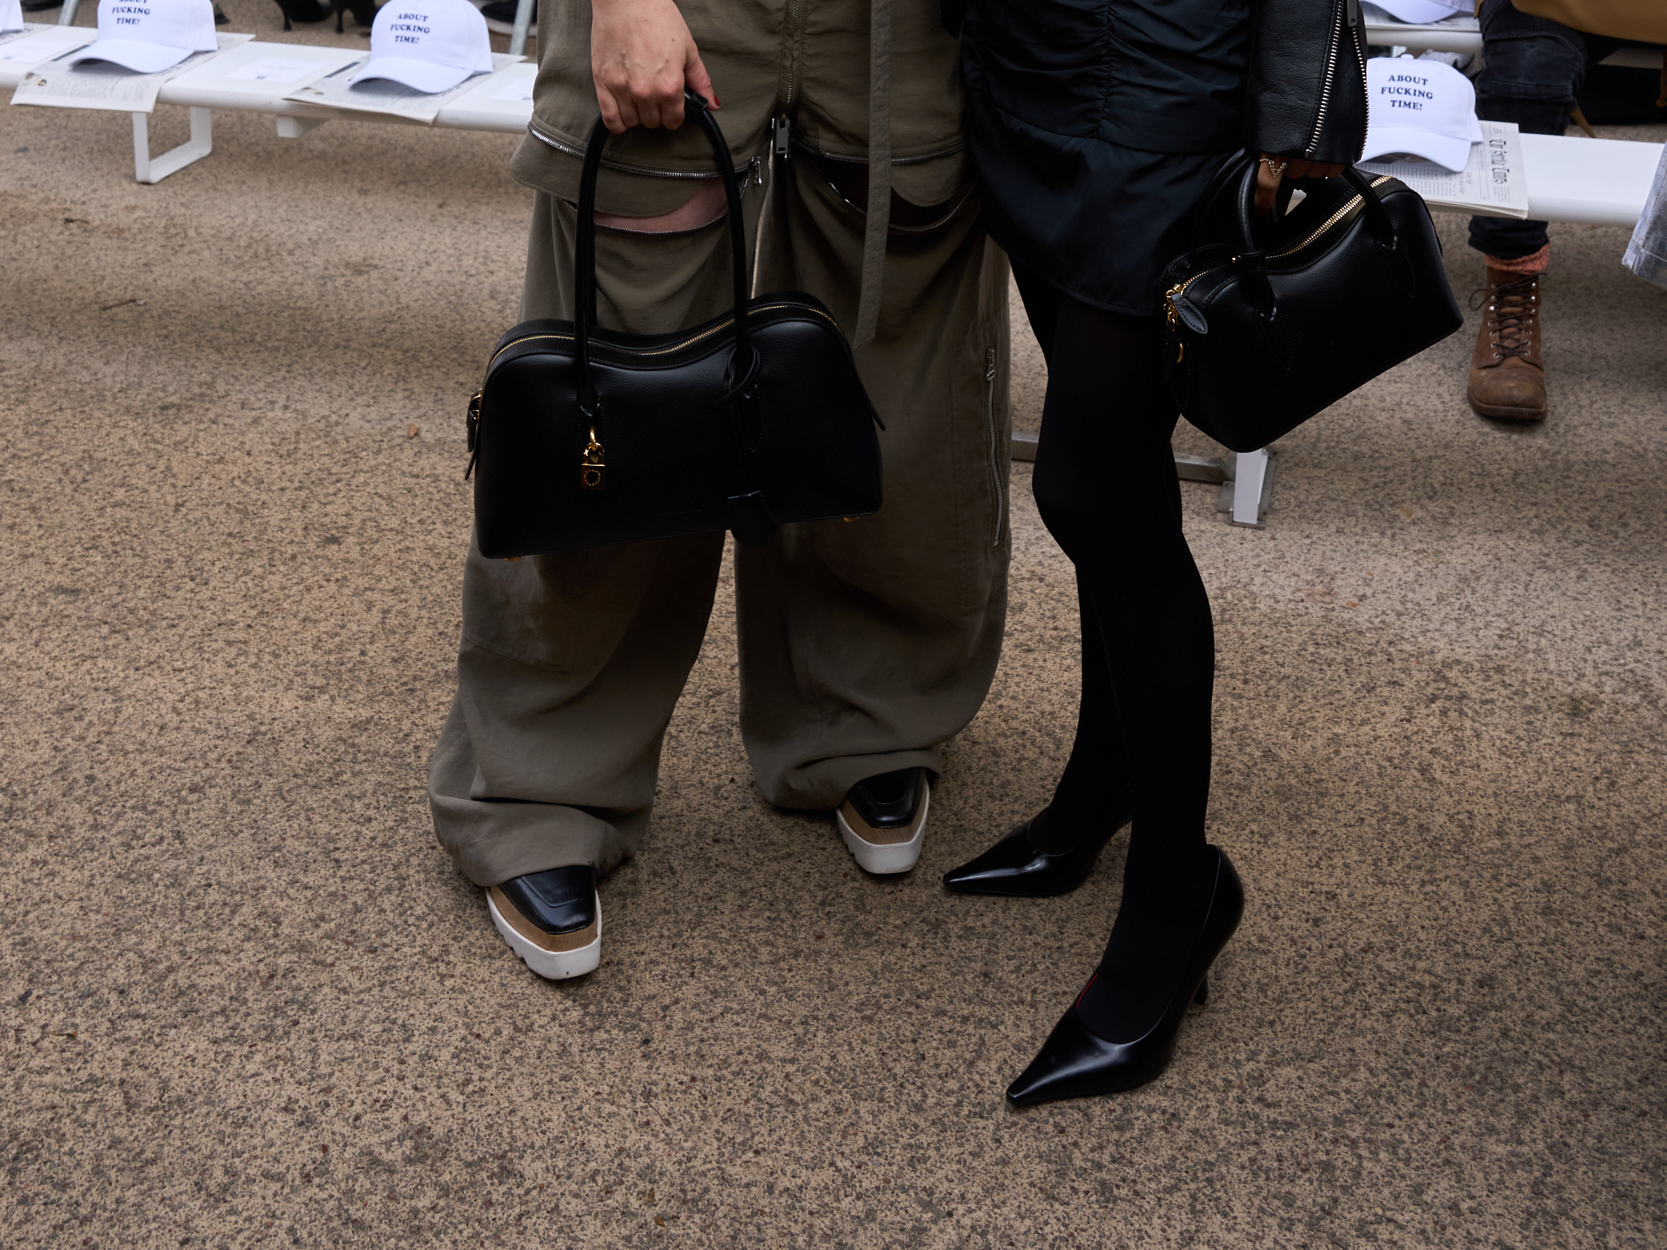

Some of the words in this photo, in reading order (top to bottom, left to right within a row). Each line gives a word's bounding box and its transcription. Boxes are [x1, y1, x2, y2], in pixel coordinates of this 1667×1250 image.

[111, 6, 150, 15] FUCKING
[116, 17, 140, 26] TIME!
[396, 13, 429, 22] ABOUT
[390, 24, 430, 34] FUCKING
[395, 35, 420, 45] TIME!
[1388, 74, 1429, 86] ABOUT
[1380, 86, 1433, 100] FUCKING
[1390, 99, 1423, 111] TIME!
